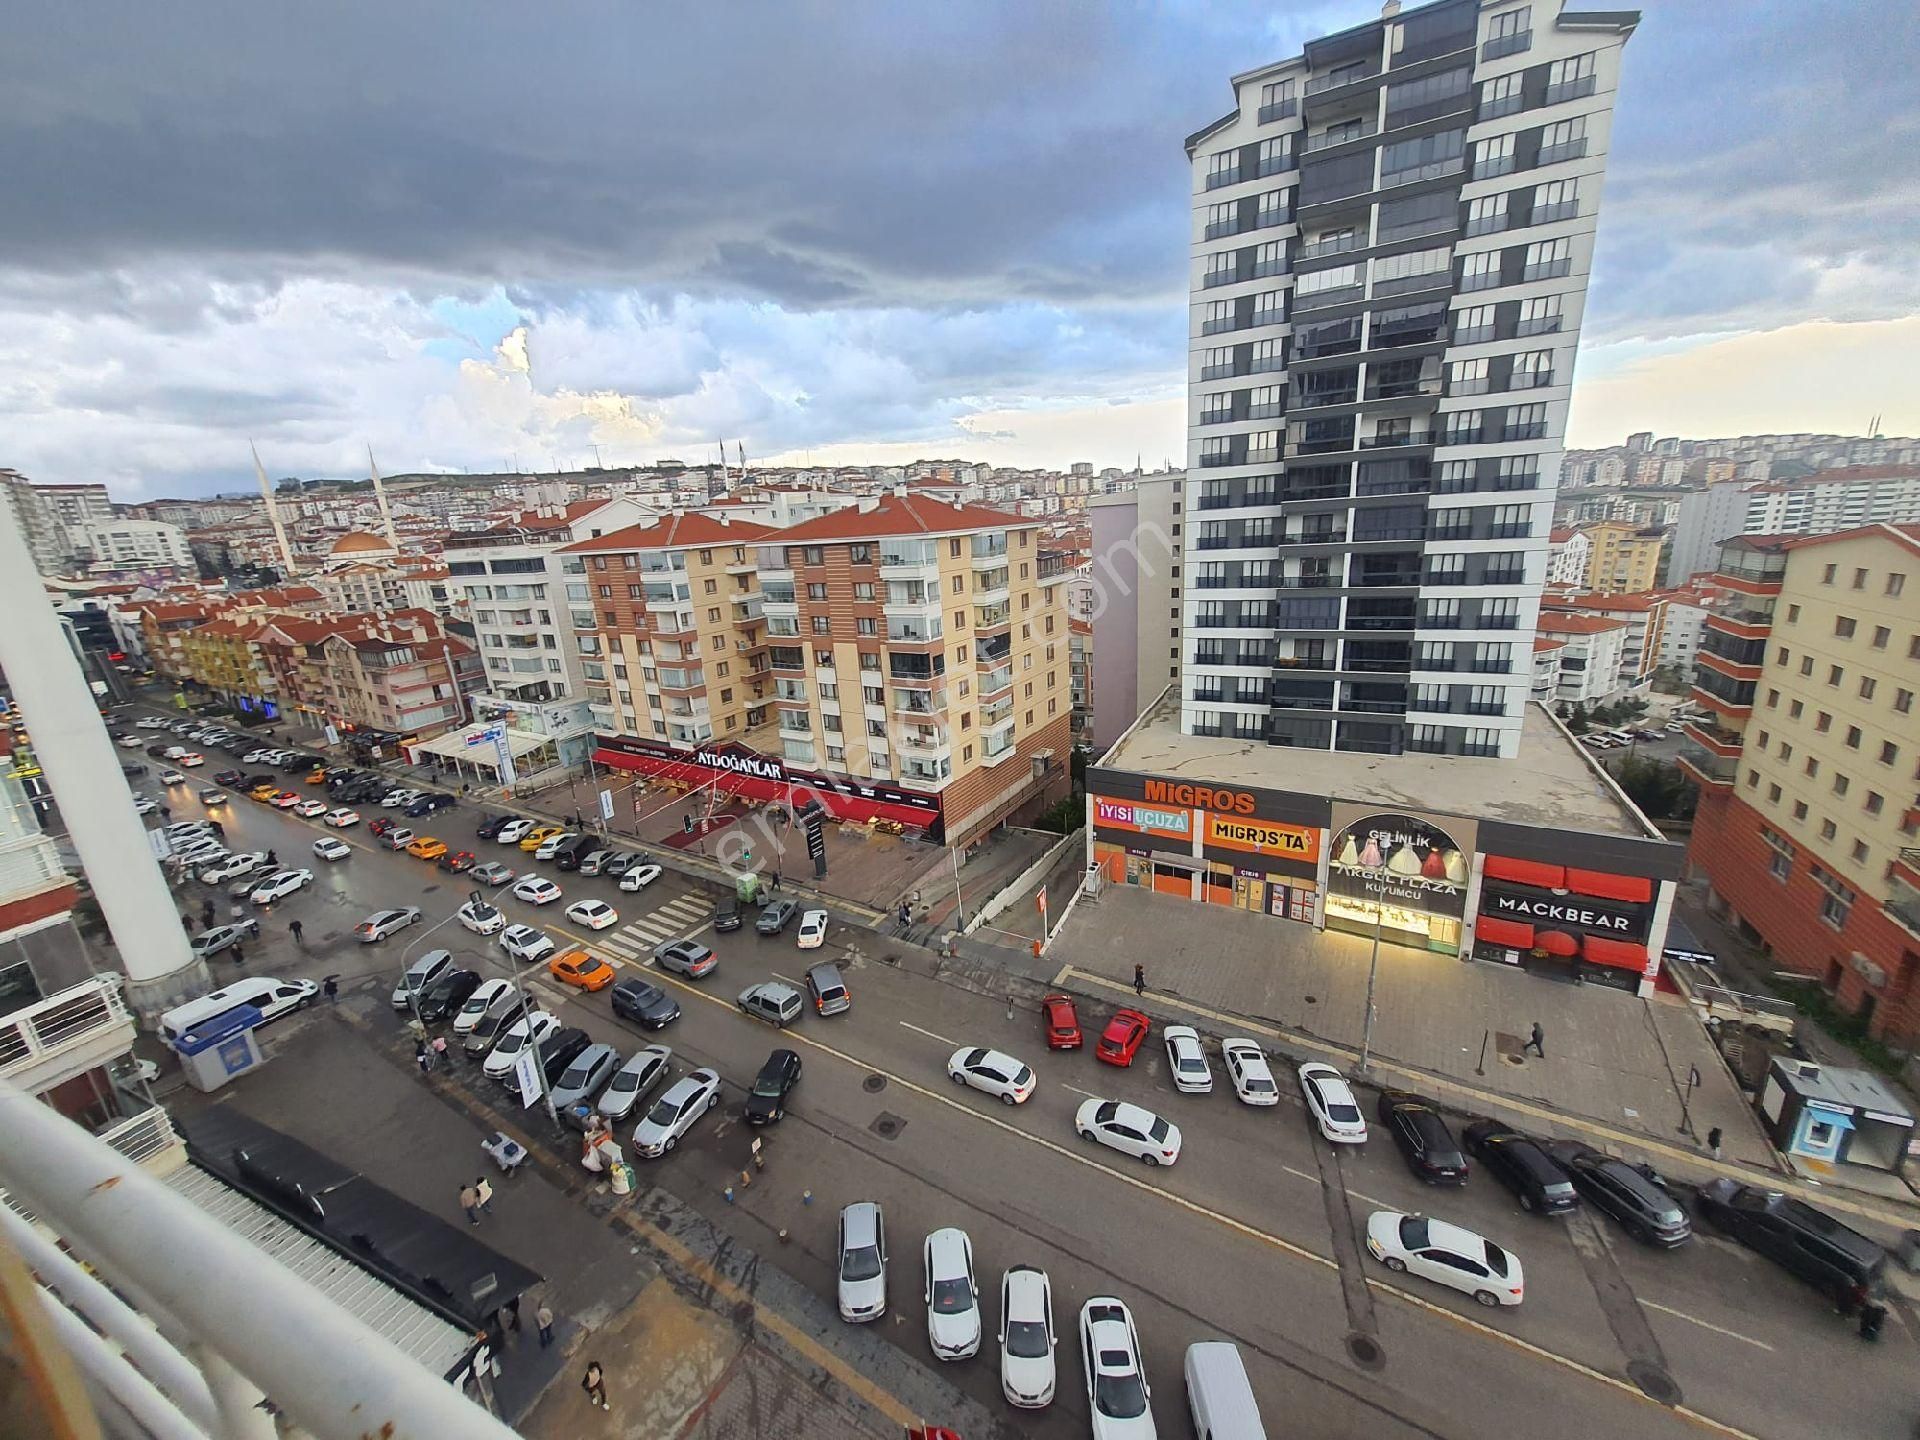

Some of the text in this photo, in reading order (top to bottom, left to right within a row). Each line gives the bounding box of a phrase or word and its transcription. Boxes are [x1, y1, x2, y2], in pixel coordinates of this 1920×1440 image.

[697, 751, 782, 779] AYDOĞANLAR
[1134, 809, 1185, 831] UCUZA
[1365, 882, 1422, 900] KUYUMCU
[1399, 876, 1457, 896] PLAZA
[1498, 897, 1630, 931] MACKBEAR
